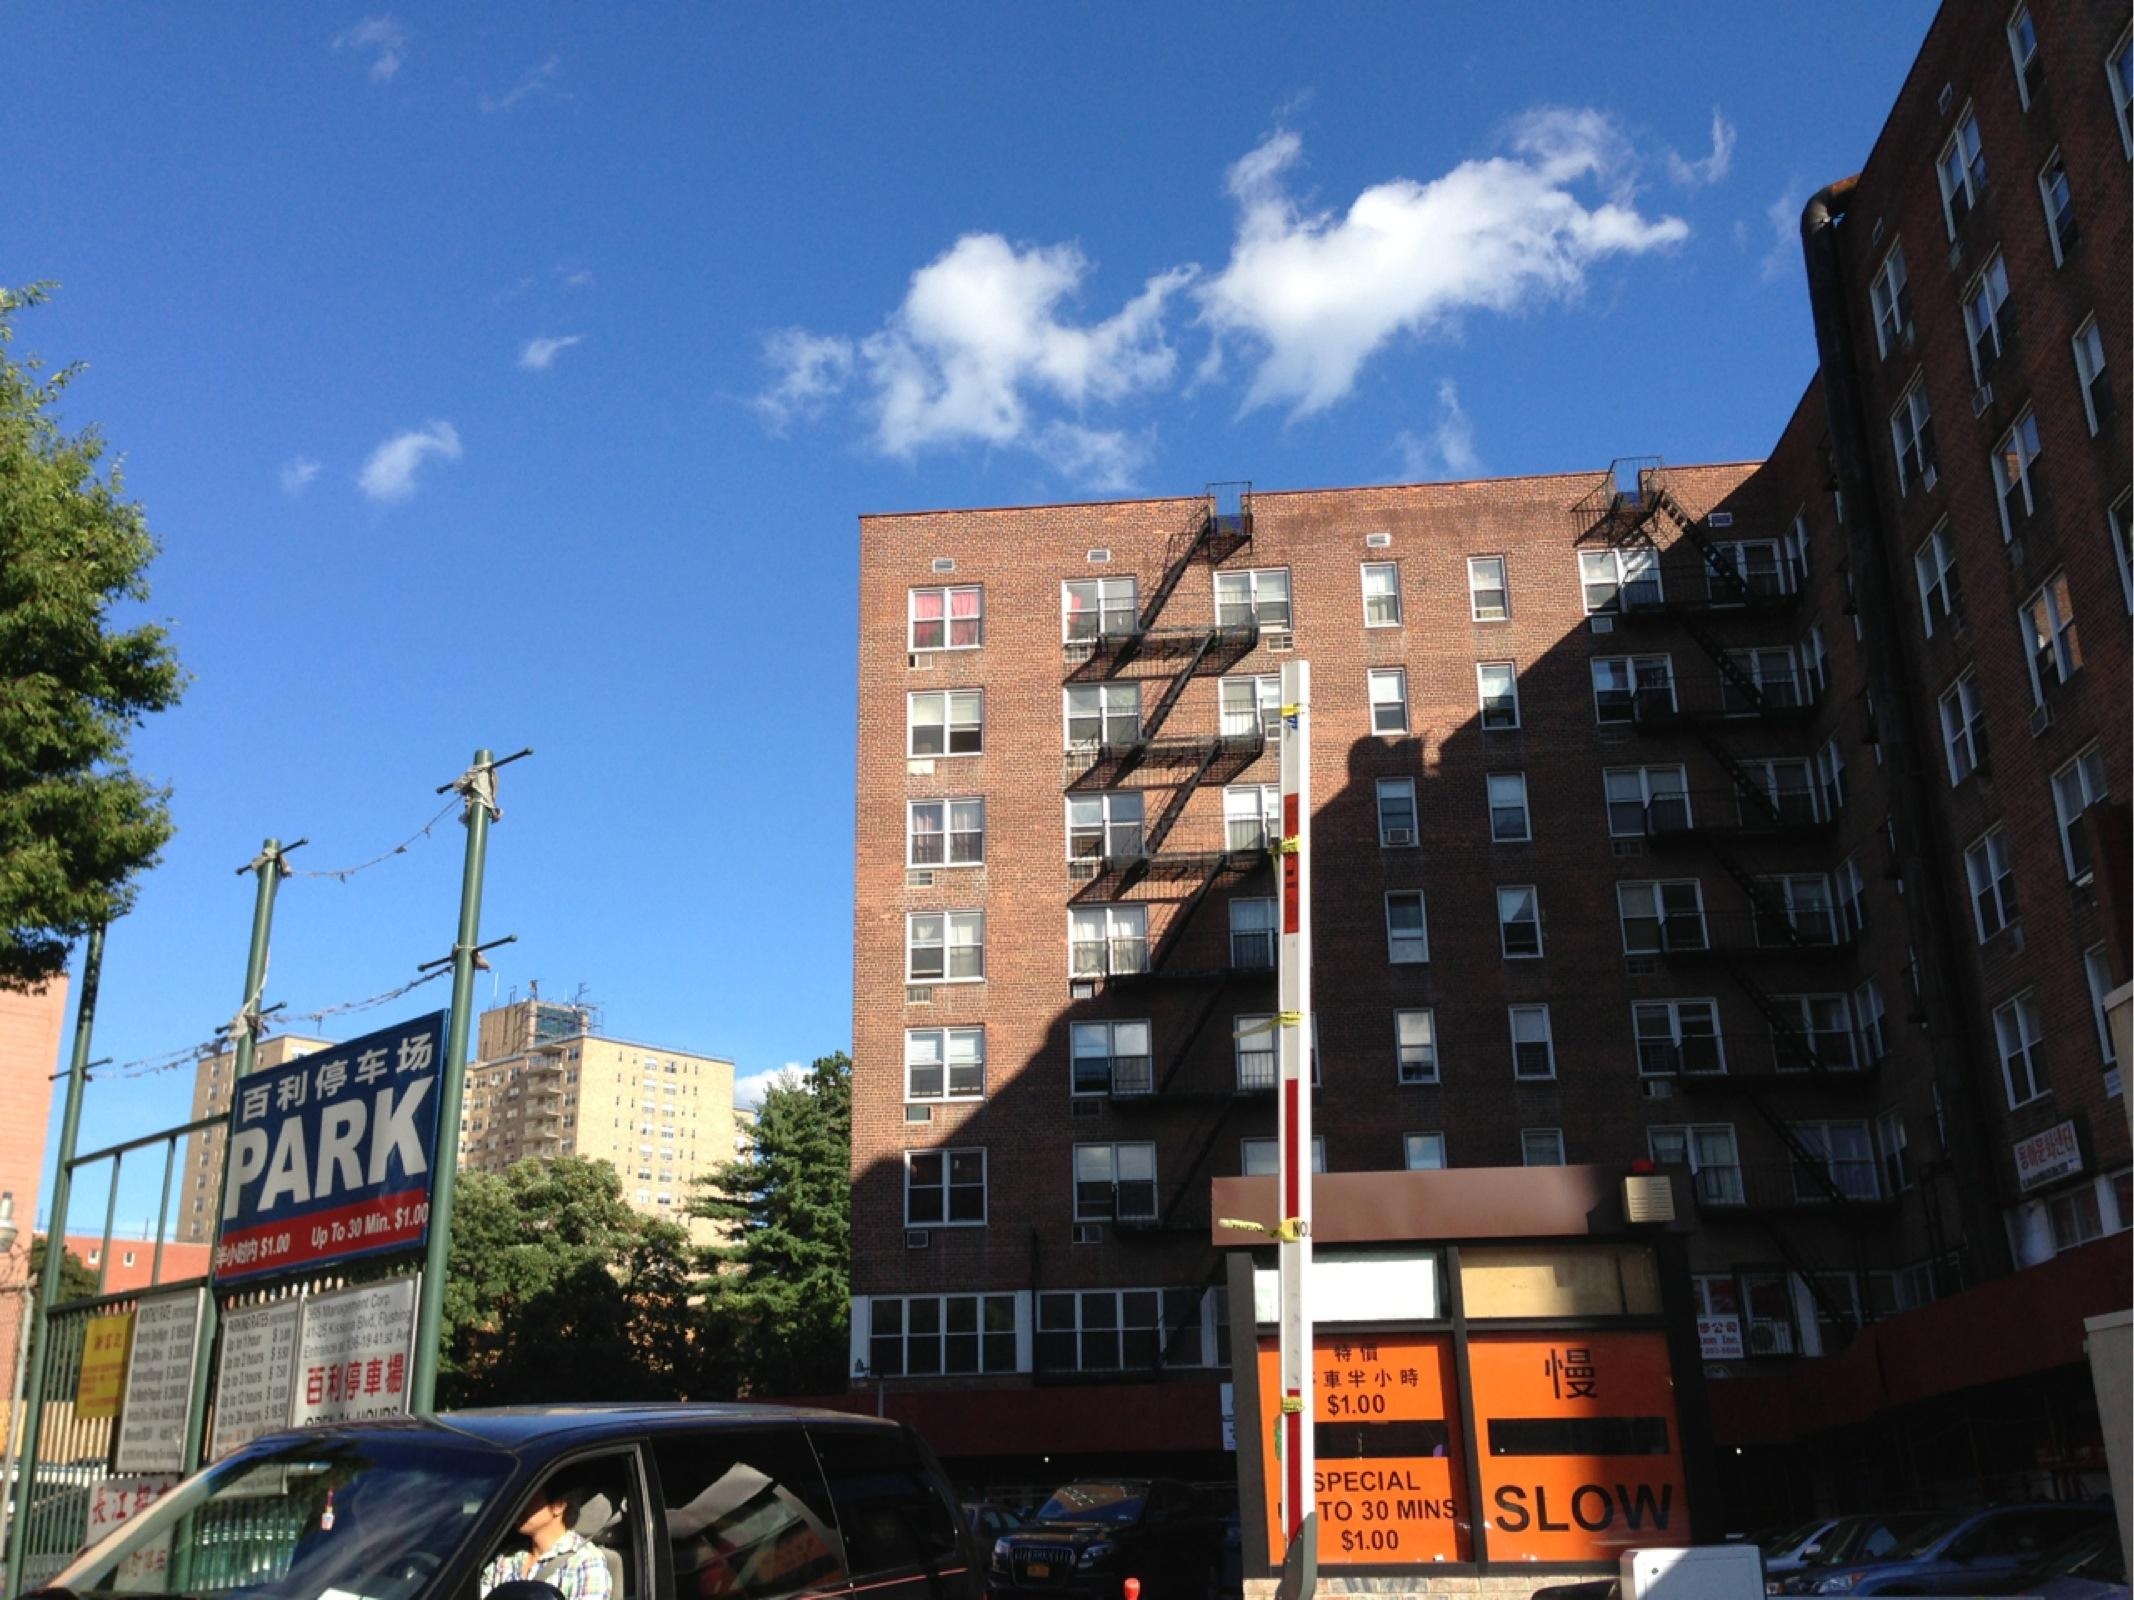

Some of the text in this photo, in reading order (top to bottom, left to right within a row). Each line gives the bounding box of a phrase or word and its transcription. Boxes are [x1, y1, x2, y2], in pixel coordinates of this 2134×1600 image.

[242, 1032, 433, 1123] 百利停车场
[223, 1075, 434, 1221] PARK
[311, 1202, 429, 1250] Up To 30 Min. $1.00
[260, 1233, 291, 1258] $1.00
[1334, 1344, 1378, 1362] 特價
[306, 1352, 404, 1406] 百利停車場
[1313, 1368, 1418, 1388] 車半小時
[1545, 1348, 1598, 1399] 慢
[1327, 1394, 1385, 1416] $1.00
[1315, 1470, 1421, 1492] SPECIAL
[1319, 1499, 1458, 1521] TO 30 MINS
[1494, 1483, 1673, 1533] SLOW
[1341, 1529, 1399, 1552] $1.00
